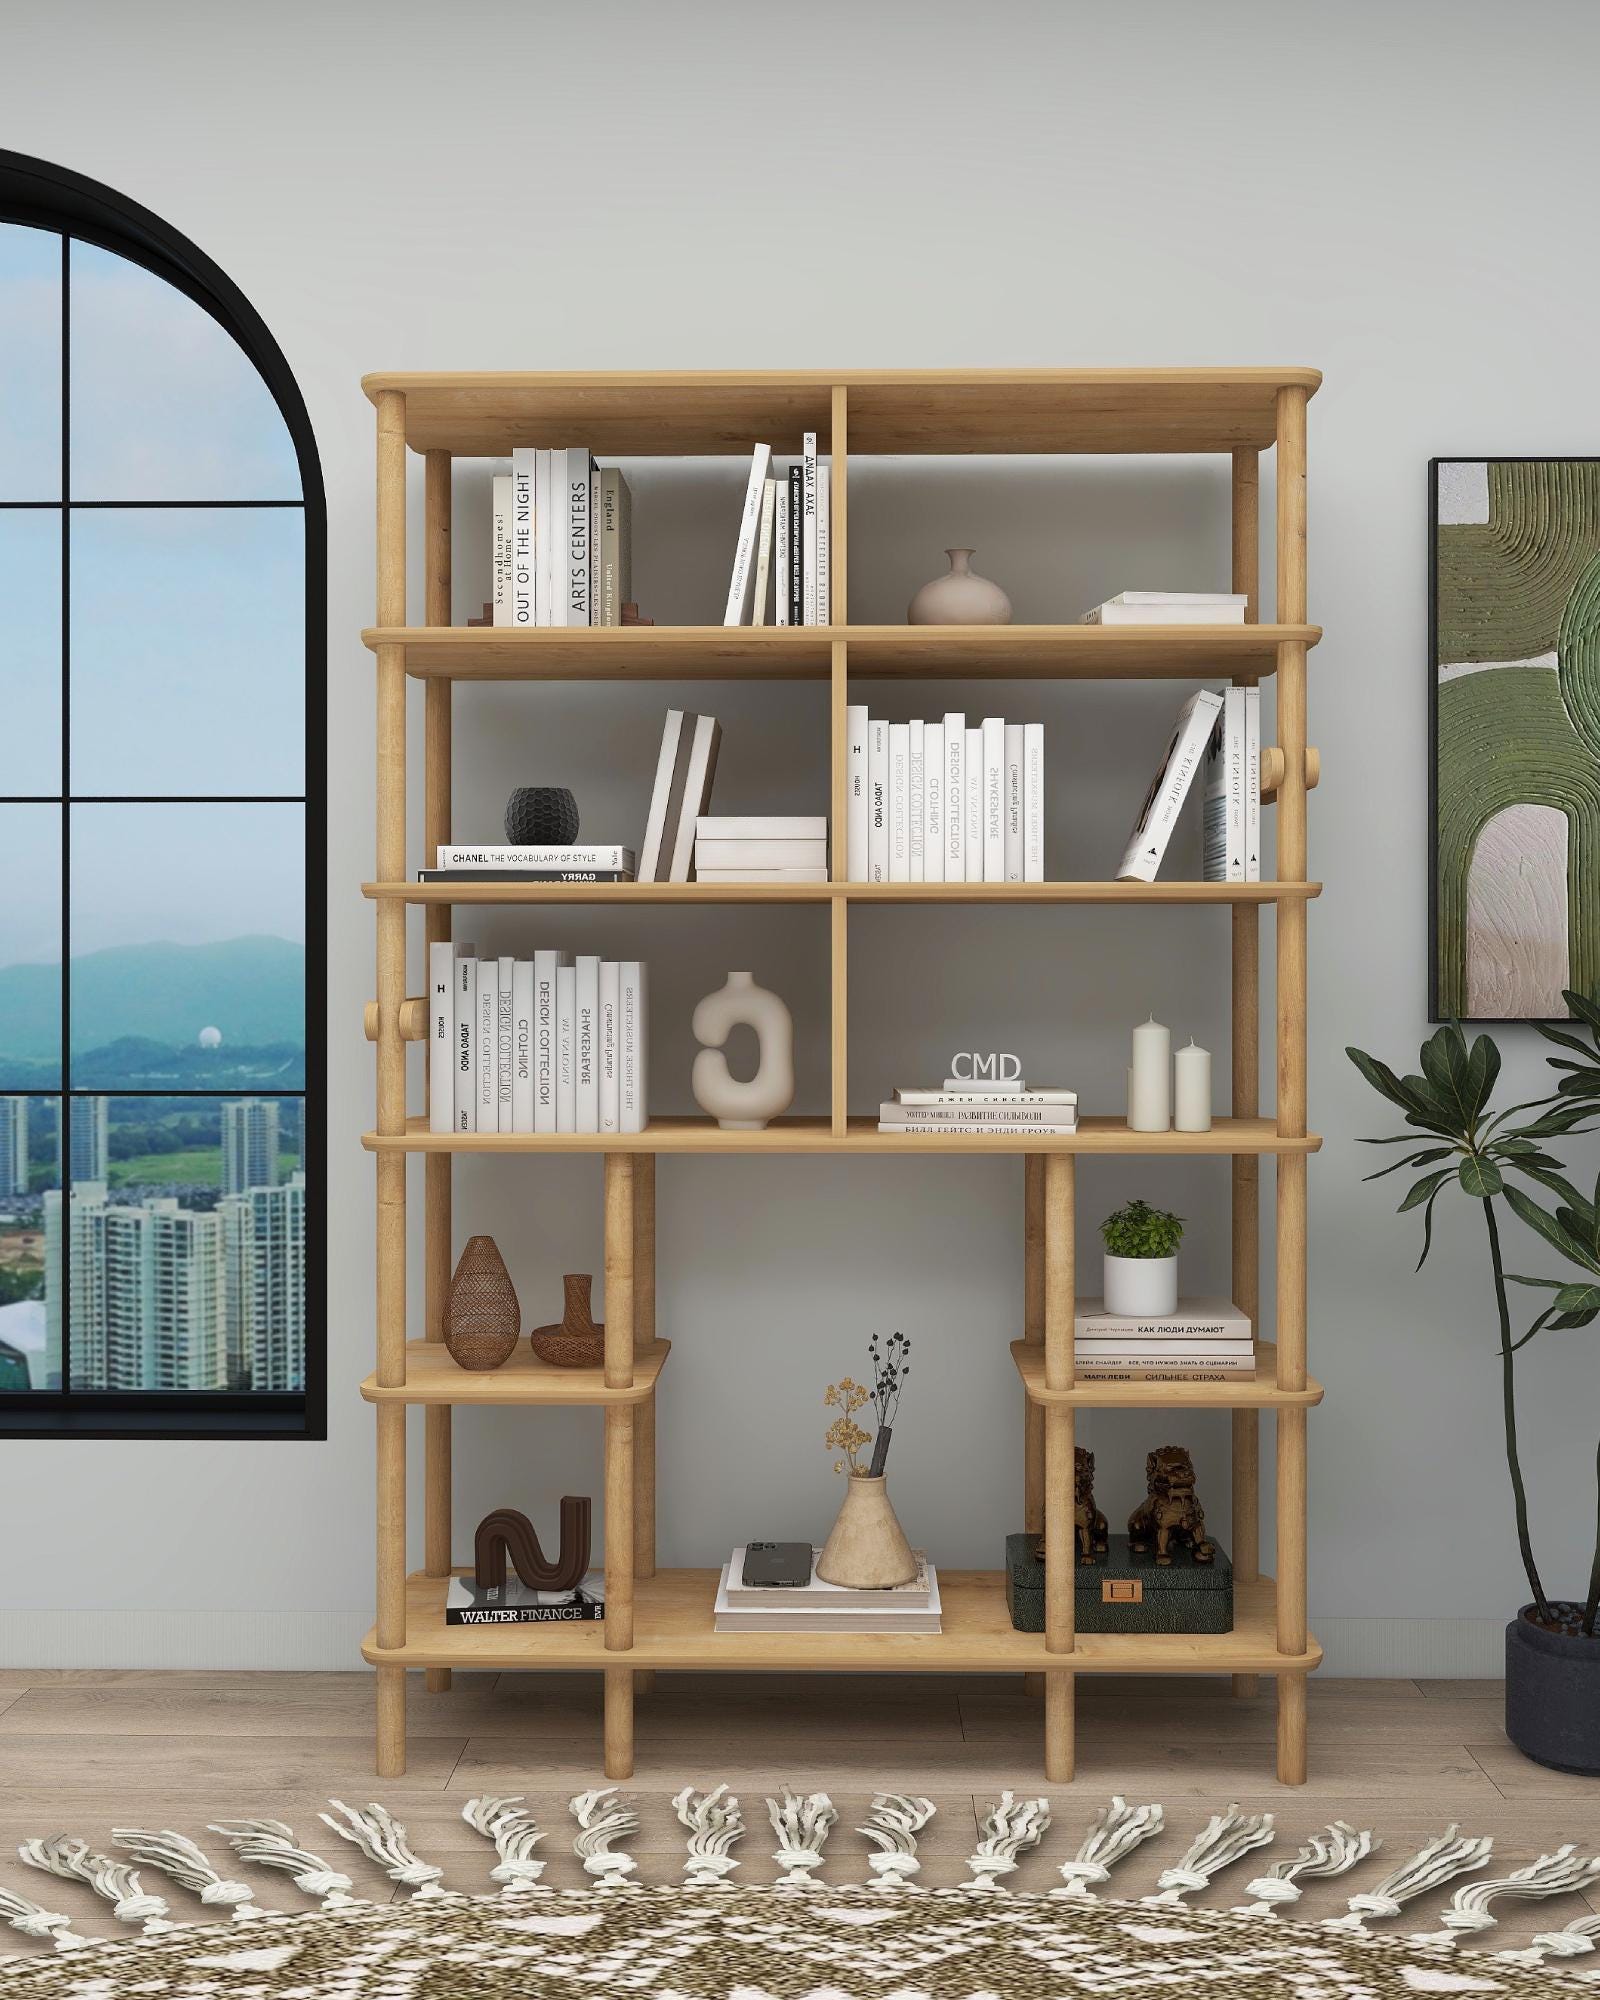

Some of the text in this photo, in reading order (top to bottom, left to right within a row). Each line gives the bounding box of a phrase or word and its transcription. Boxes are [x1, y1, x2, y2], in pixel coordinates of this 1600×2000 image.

[604, 490, 614, 532] England
[494, 513, 504, 604] Secondhomes!
[504, 538, 512, 581] at Home
[517, 472, 530, 622] OUT OF THE NIGHT
[572, 482, 586, 612] ARTS CENTERS
[452, 854, 596, 863] CHANEL THE VOCABULARY OF STYLE
[951, 1052, 1022, 1081] CMD
[938, 1126, 972, 1134] ГЕЙТС
[958, 1112, 998, 1120] РАЗВИТИЕ
[1157, 1326, 1184, 1334] ЛЮДИ
[1186, 1326, 1224, 1334] ДУМАЮТ
[460, 1608, 582, 1624] WALTER FINANCE
